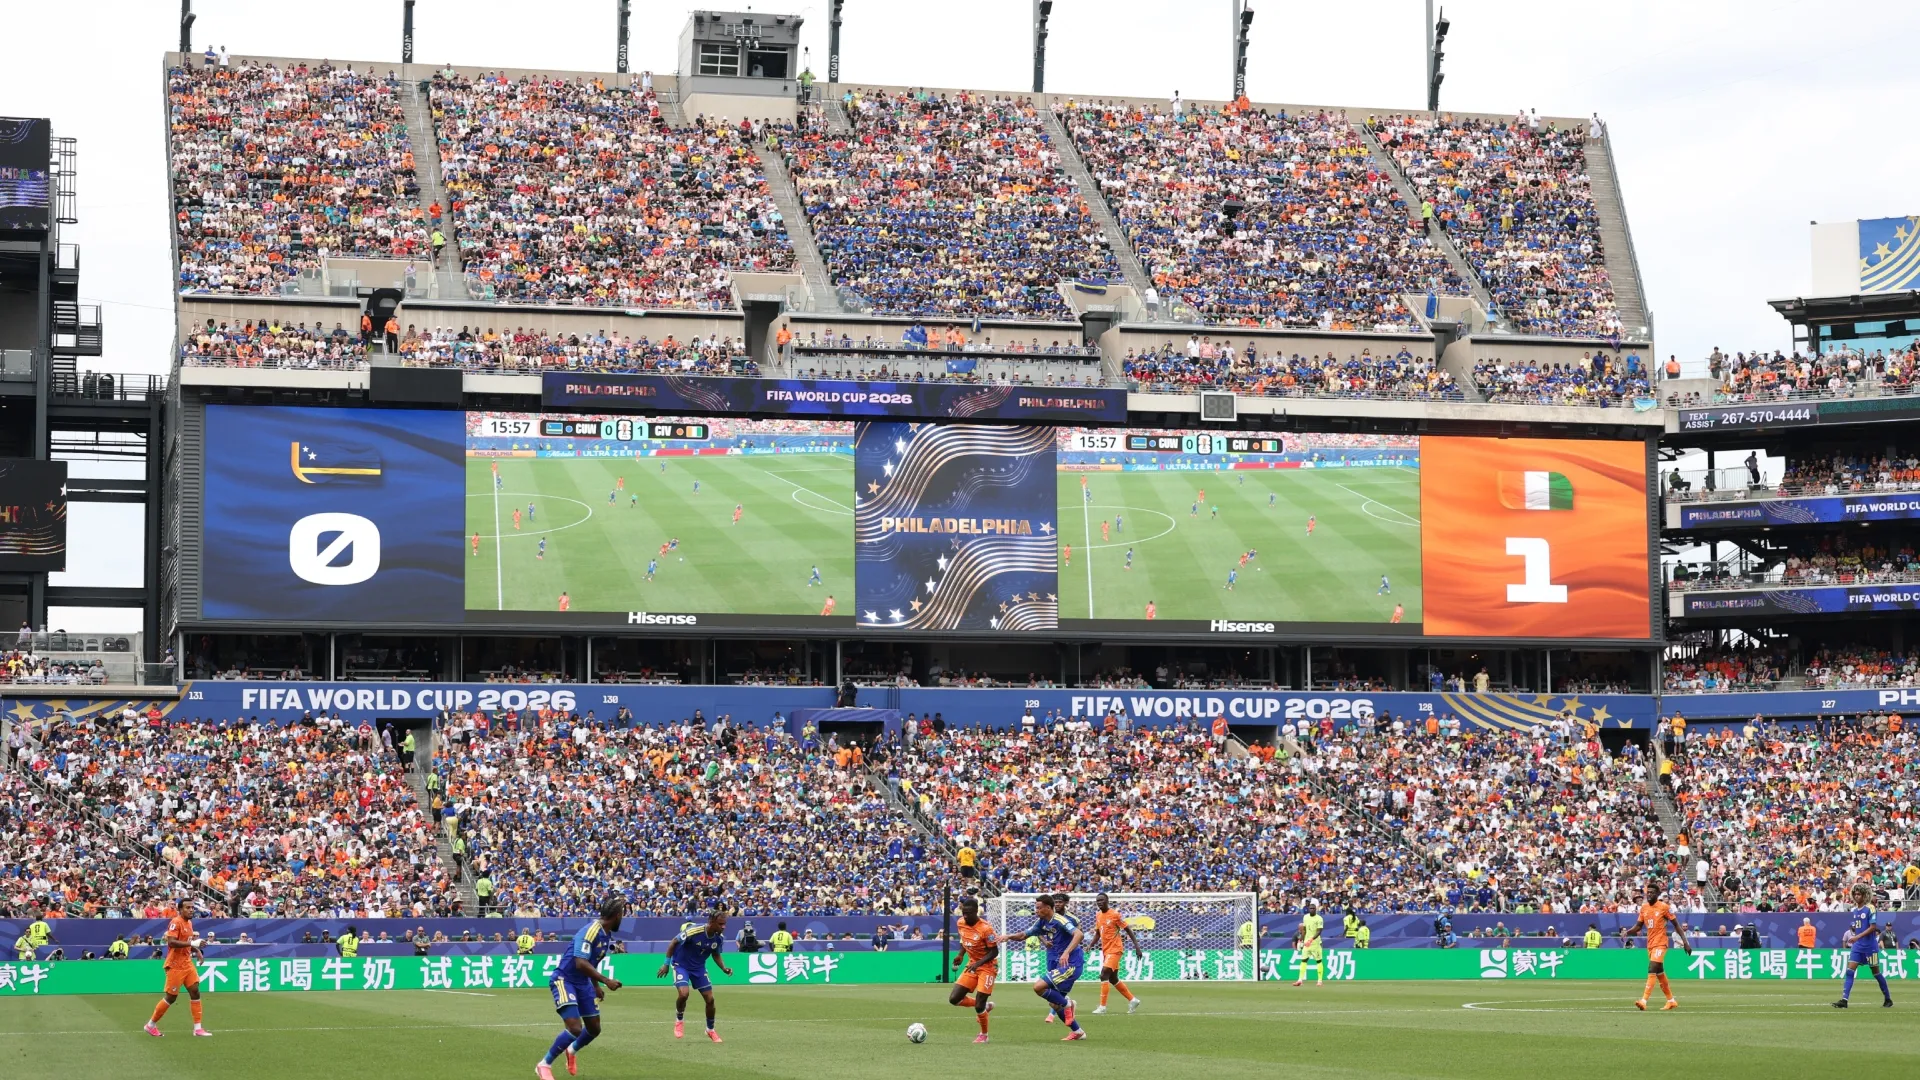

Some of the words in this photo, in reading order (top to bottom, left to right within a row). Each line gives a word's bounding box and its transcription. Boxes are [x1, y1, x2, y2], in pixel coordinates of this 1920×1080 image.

[619, 44, 627, 68] 236
[830, 54, 838, 78] 235
[566, 384, 657, 397] PHILADELPHIA
[766, 390, 794, 403] FIFA
[795, 391, 841, 403] WORLD
[842, 393, 868, 404] CUP
[868, 393, 913, 405] 2026
[1018, 397, 1106, 410] PHILADELPHIA
[1688, 412, 1710, 421] TEXT
[1721, 408, 1811, 425] 267-570-4444
[490, 421, 531, 434] 15:57
[575, 423, 597, 435] CUW
[605, 425, 613, 436] 0
[637, 425, 643, 437] 1
[654, 425, 672, 437] CIV
[1685, 420, 1715, 429] ASSIST
[1080, 436, 1117, 449] 15:57
[1158, 437, 1179, 449] CUW
[1186, 439, 1193, 450] 0
[1216, 440, 1222, 451] 1
[1232, 439, 1249, 451] CIV
[1688, 508, 1762, 521] PHILADELPHIA
[1845, 503, 1868, 514] FIFA
[1869, 502, 1908, 513] WORLD
[881, 517, 1033, 535] PHILADELPHIA
[1505, 537, 1568, 603] 1
[1691, 598, 1765, 610] PHILADELPHIA
[1848, 594, 1872, 604] FIFA
[1872, 593, 1911, 603] WORLD
[627, 611, 697, 625] Hisense
[1210, 619, 1275, 633] Hisense
[188, 691, 204, 700] 131
[242, 688, 304, 710] FIFA
[305, 688, 411, 711] WORLD
[416, 689, 473, 711] CUP
[477, 690, 577, 711] 2026
[603, 694, 619, 704] 130
[1025, 699, 1040, 708] 129
[1071, 696, 1126, 717] FIFA
[1129, 696, 1225, 718] WORLD
[1229, 697, 1281, 719] CUP
[1285, 697, 1375, 719] 2026
[1418, 703, 1433, 711] 128
[1821, 700, 1836, 709] 127
[1687, 948, 1857, 979] 不能喝牛奶
[1879, 948, 1920, 979] 试
[197, 957, 396, 992] 不能喝牛奶
